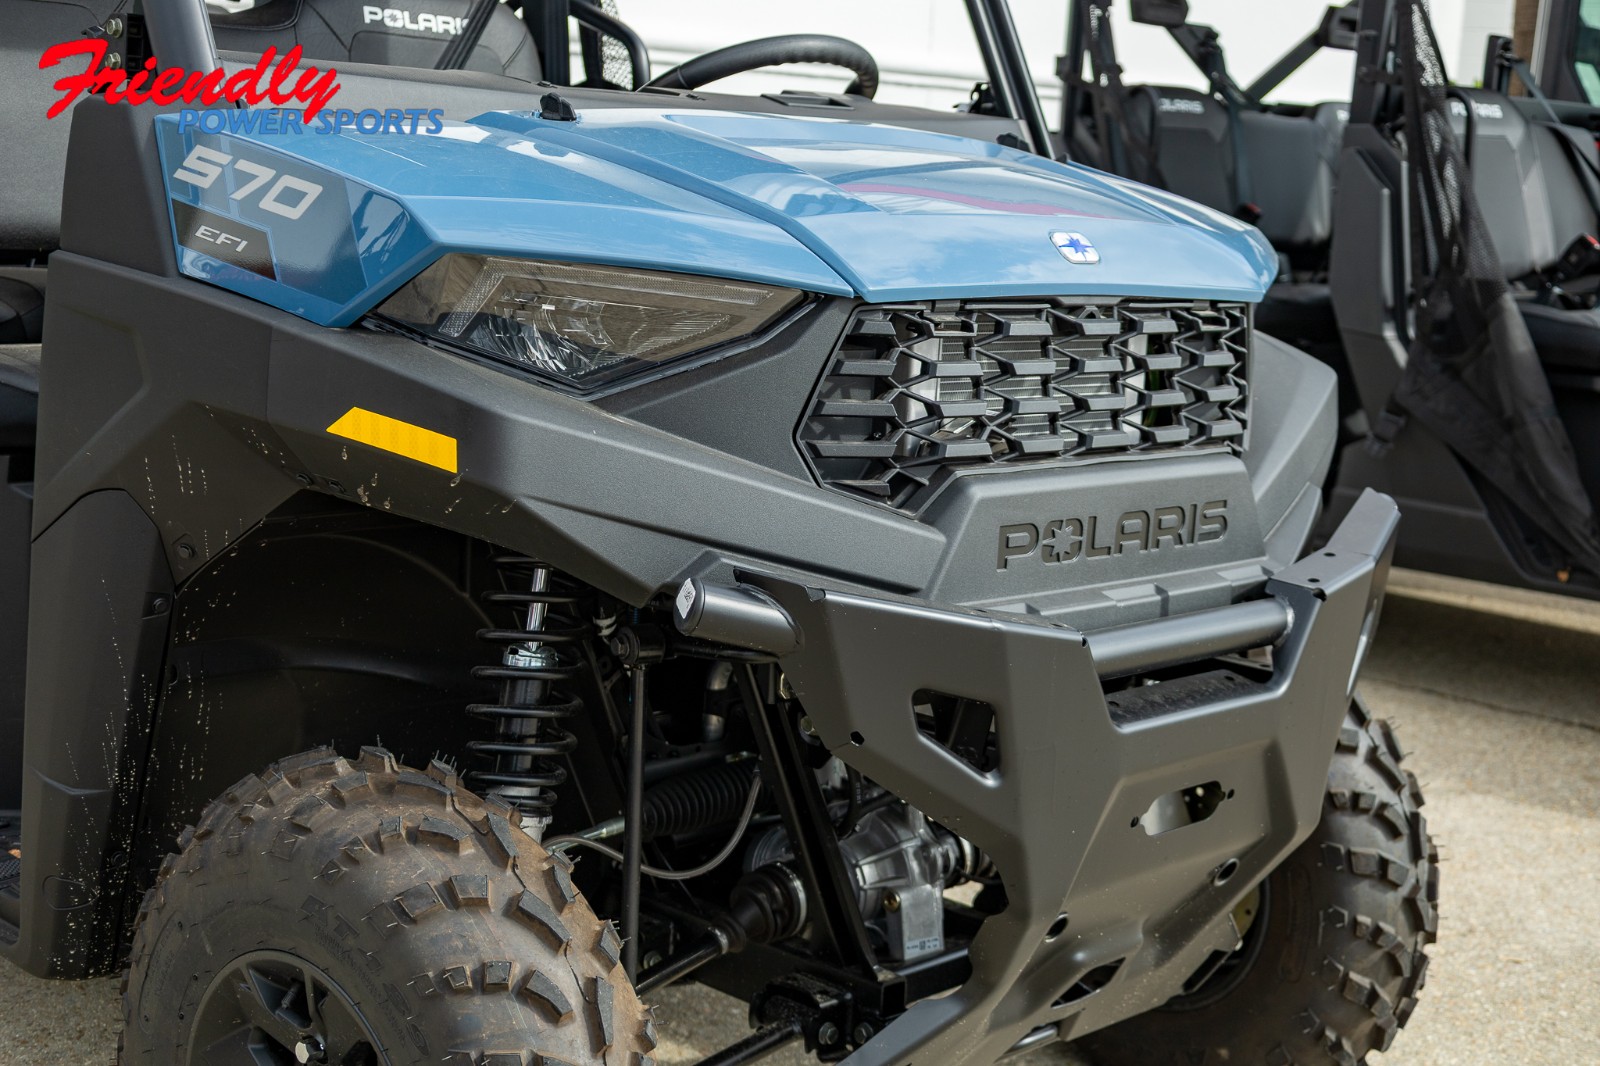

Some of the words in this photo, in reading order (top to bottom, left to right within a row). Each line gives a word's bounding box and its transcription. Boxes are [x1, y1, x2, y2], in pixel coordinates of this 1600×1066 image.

[363, 5, 469, 35] POLARI
[172, 144, 324, 220] 570
[194, 224, 249, 253] EFI
[996, 499, 1229, 573] POLARIS
